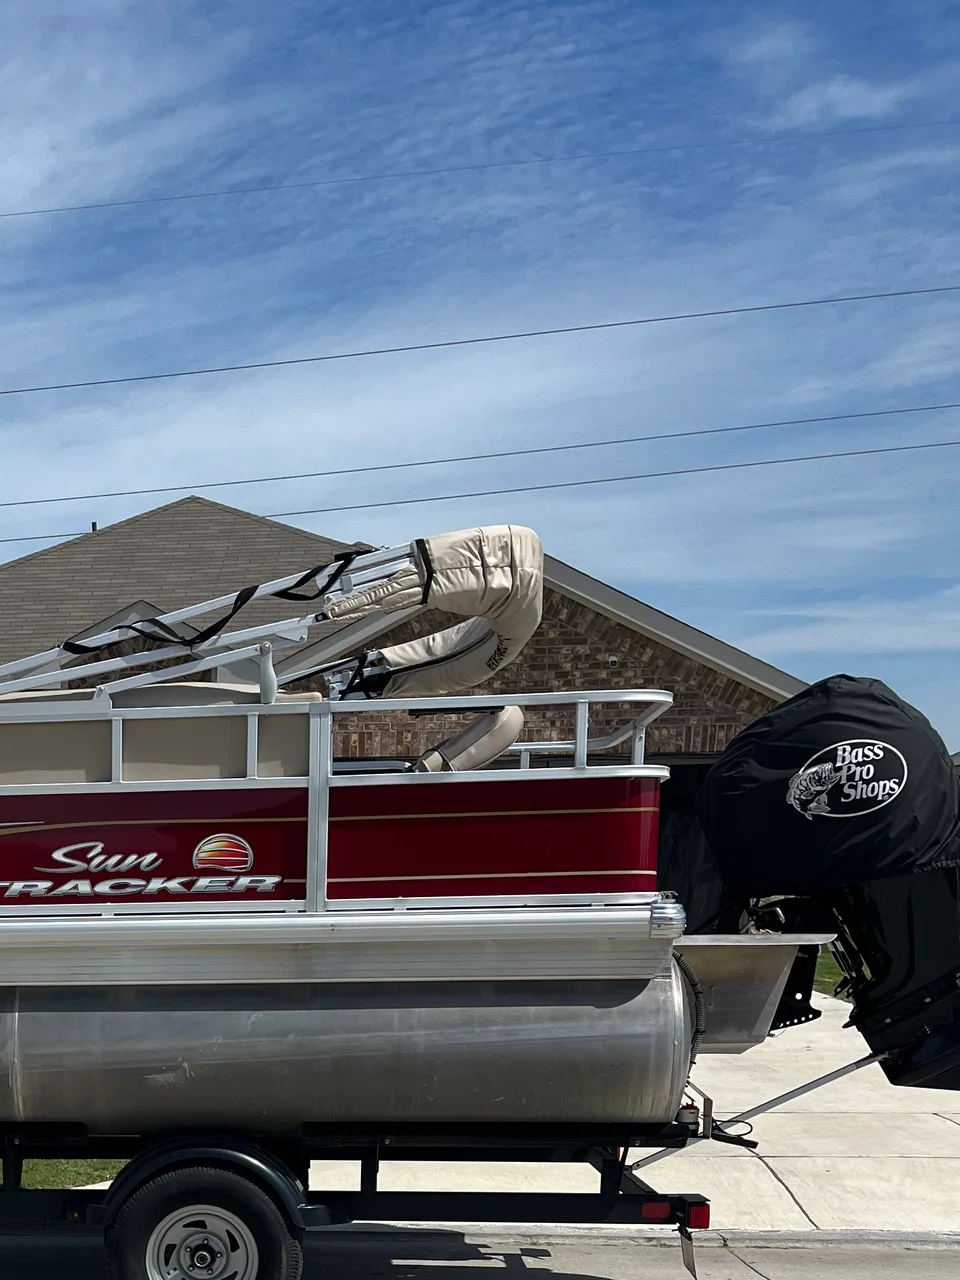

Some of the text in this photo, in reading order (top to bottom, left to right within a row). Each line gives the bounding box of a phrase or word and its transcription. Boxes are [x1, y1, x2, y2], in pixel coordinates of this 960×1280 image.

[836, 745, 884, 767] Bass
[840, 764, 874, 784] Pro
[841, 779, 899, 802] Shops
[33, 841, 163, 873] Sun
